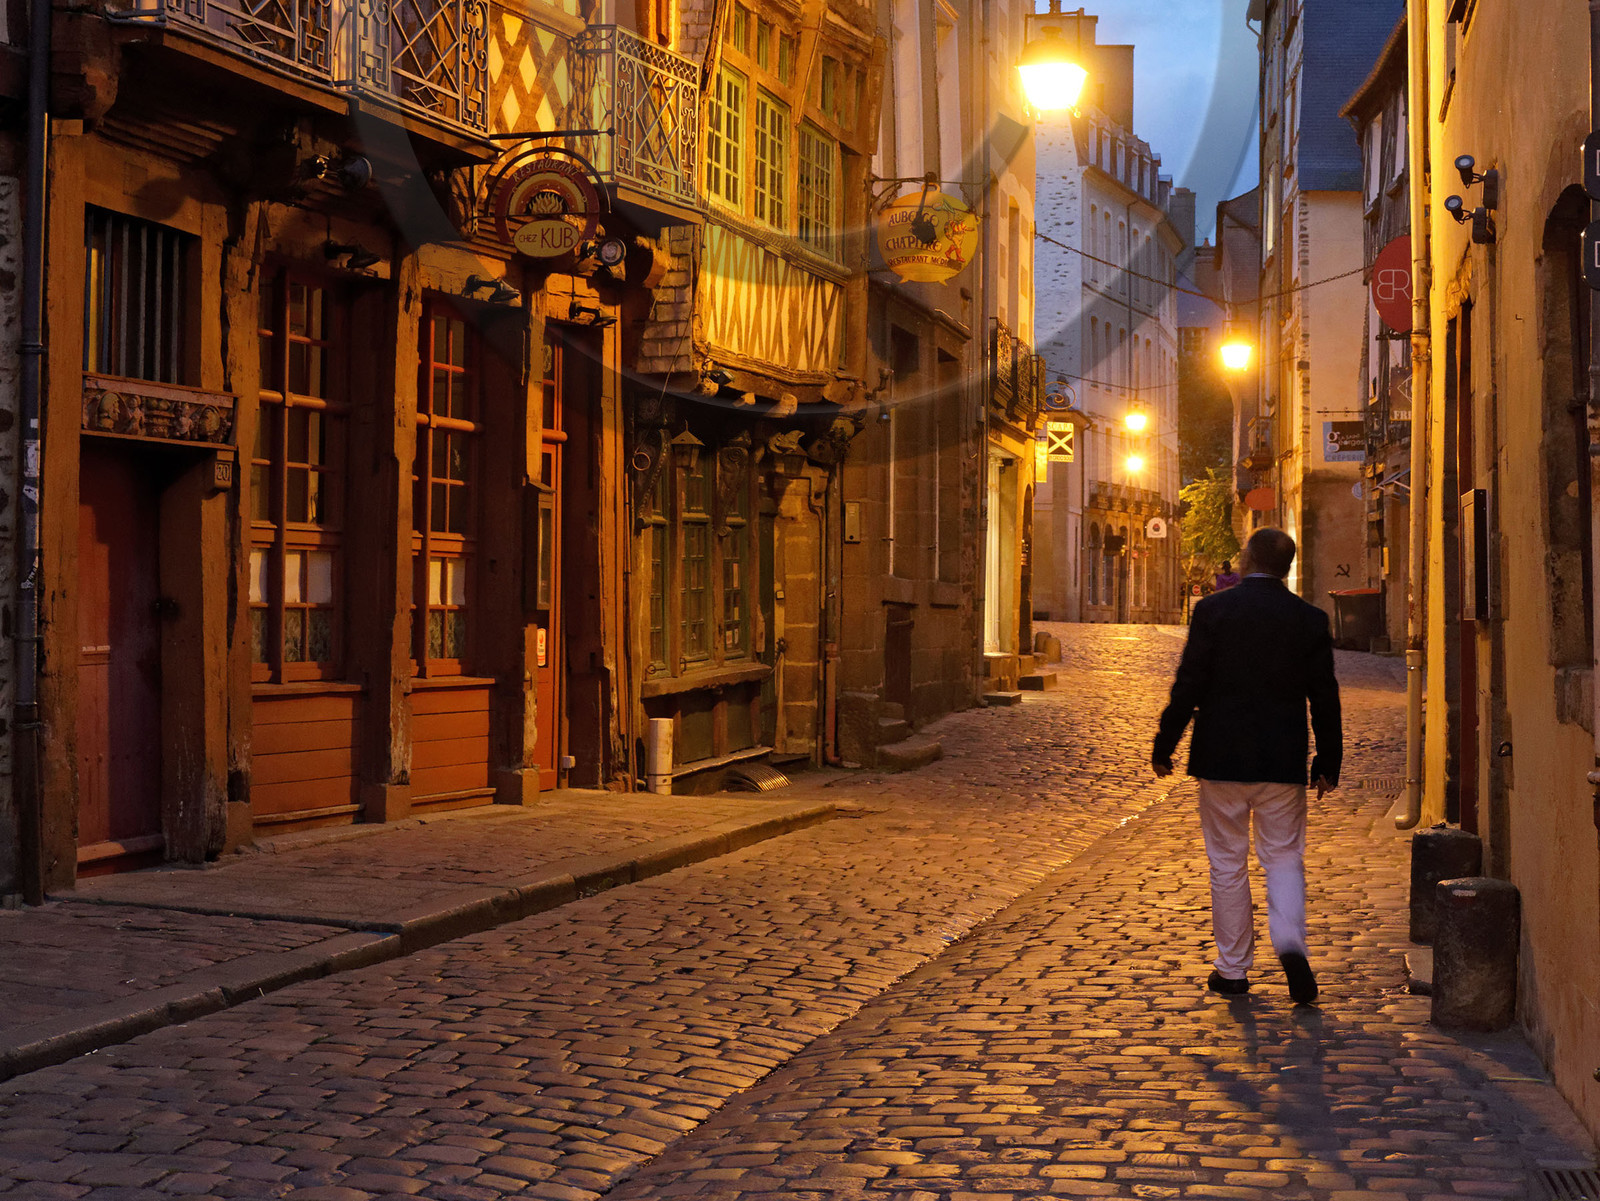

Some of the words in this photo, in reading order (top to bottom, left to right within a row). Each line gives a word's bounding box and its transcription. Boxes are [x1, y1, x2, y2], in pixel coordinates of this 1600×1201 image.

[512, 159, 579, 182] RESTAURANT
[518, 234, 538, 243] CHEZ
[541, 227, 574, 249] KUB
[888, 255, 929, 267] RESTAURANT
